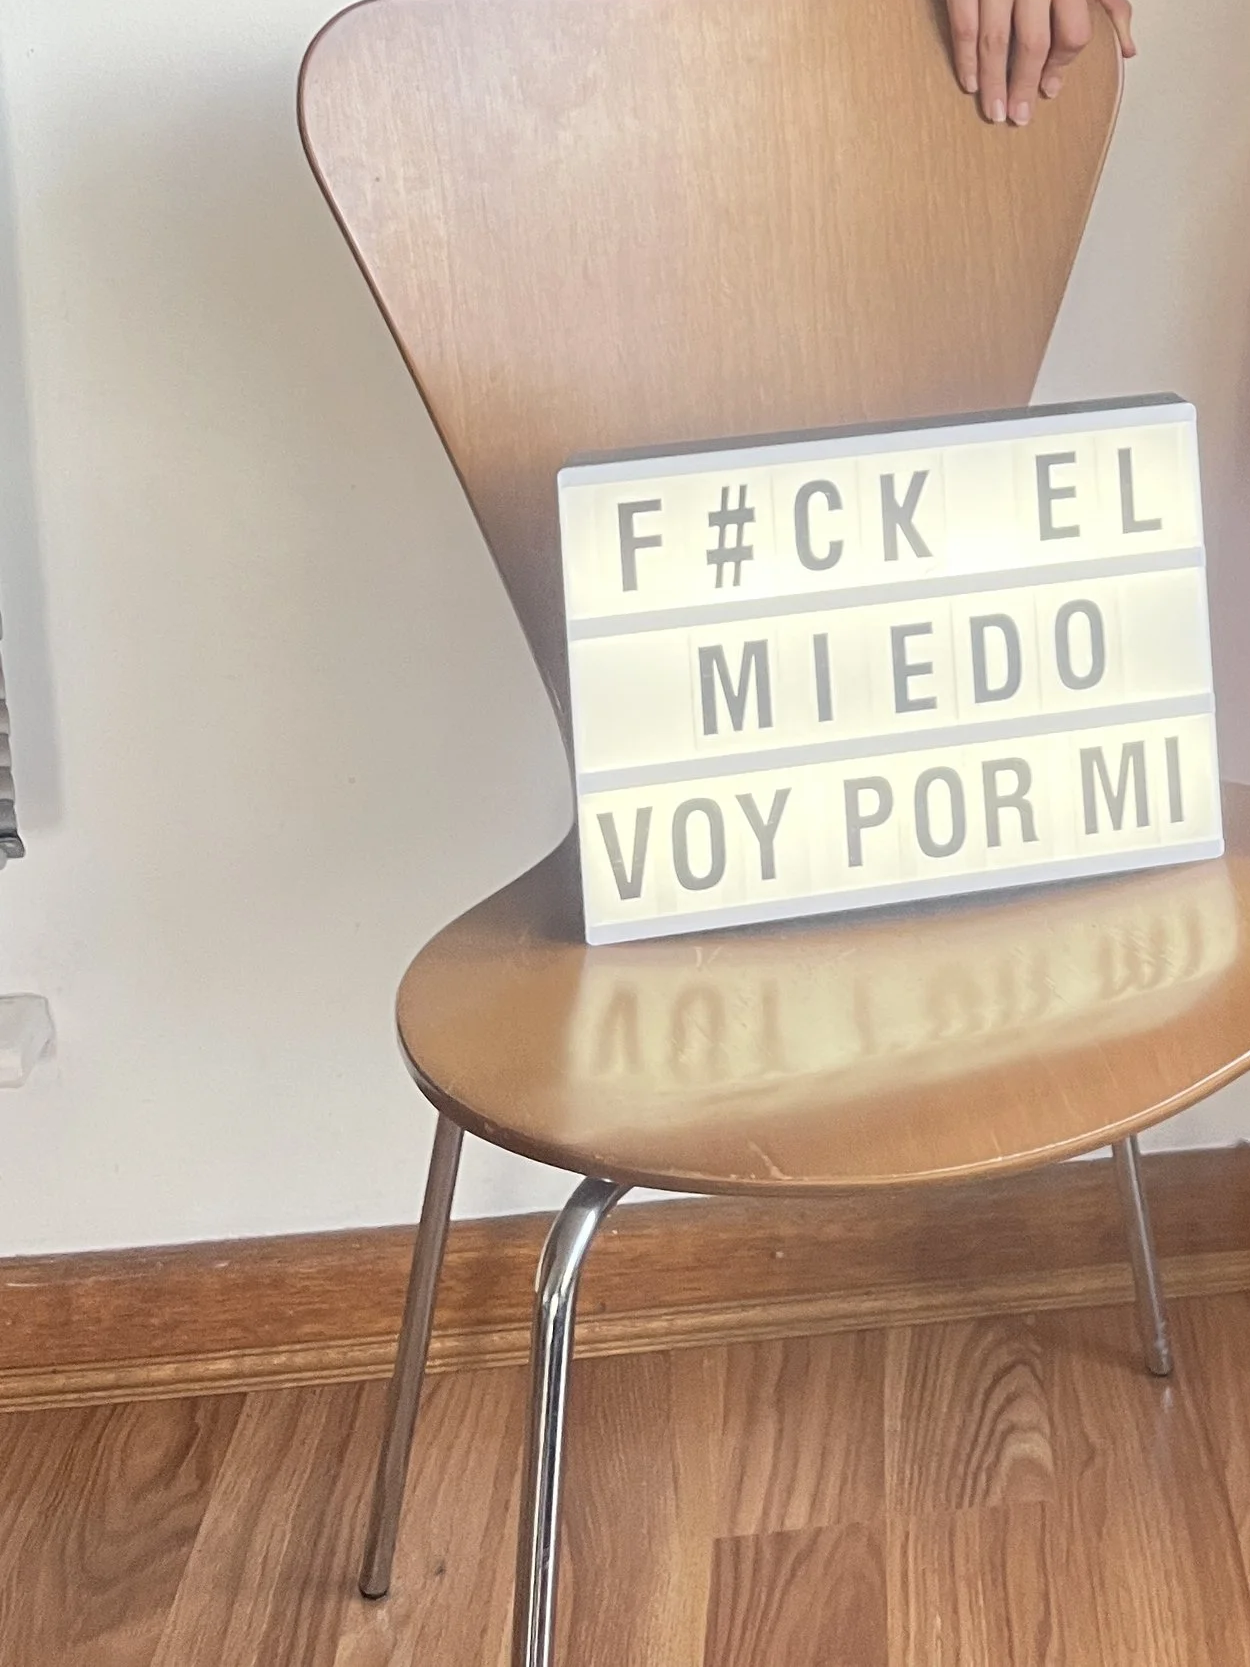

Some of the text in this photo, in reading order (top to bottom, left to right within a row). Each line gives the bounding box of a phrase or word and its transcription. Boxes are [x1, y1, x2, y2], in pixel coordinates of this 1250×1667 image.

[617, 447, 1163, 591] F#CK EL
[698, 599, 1106, 735] MIEDO
[597, 736, 1184, 900] VOY POR MI
